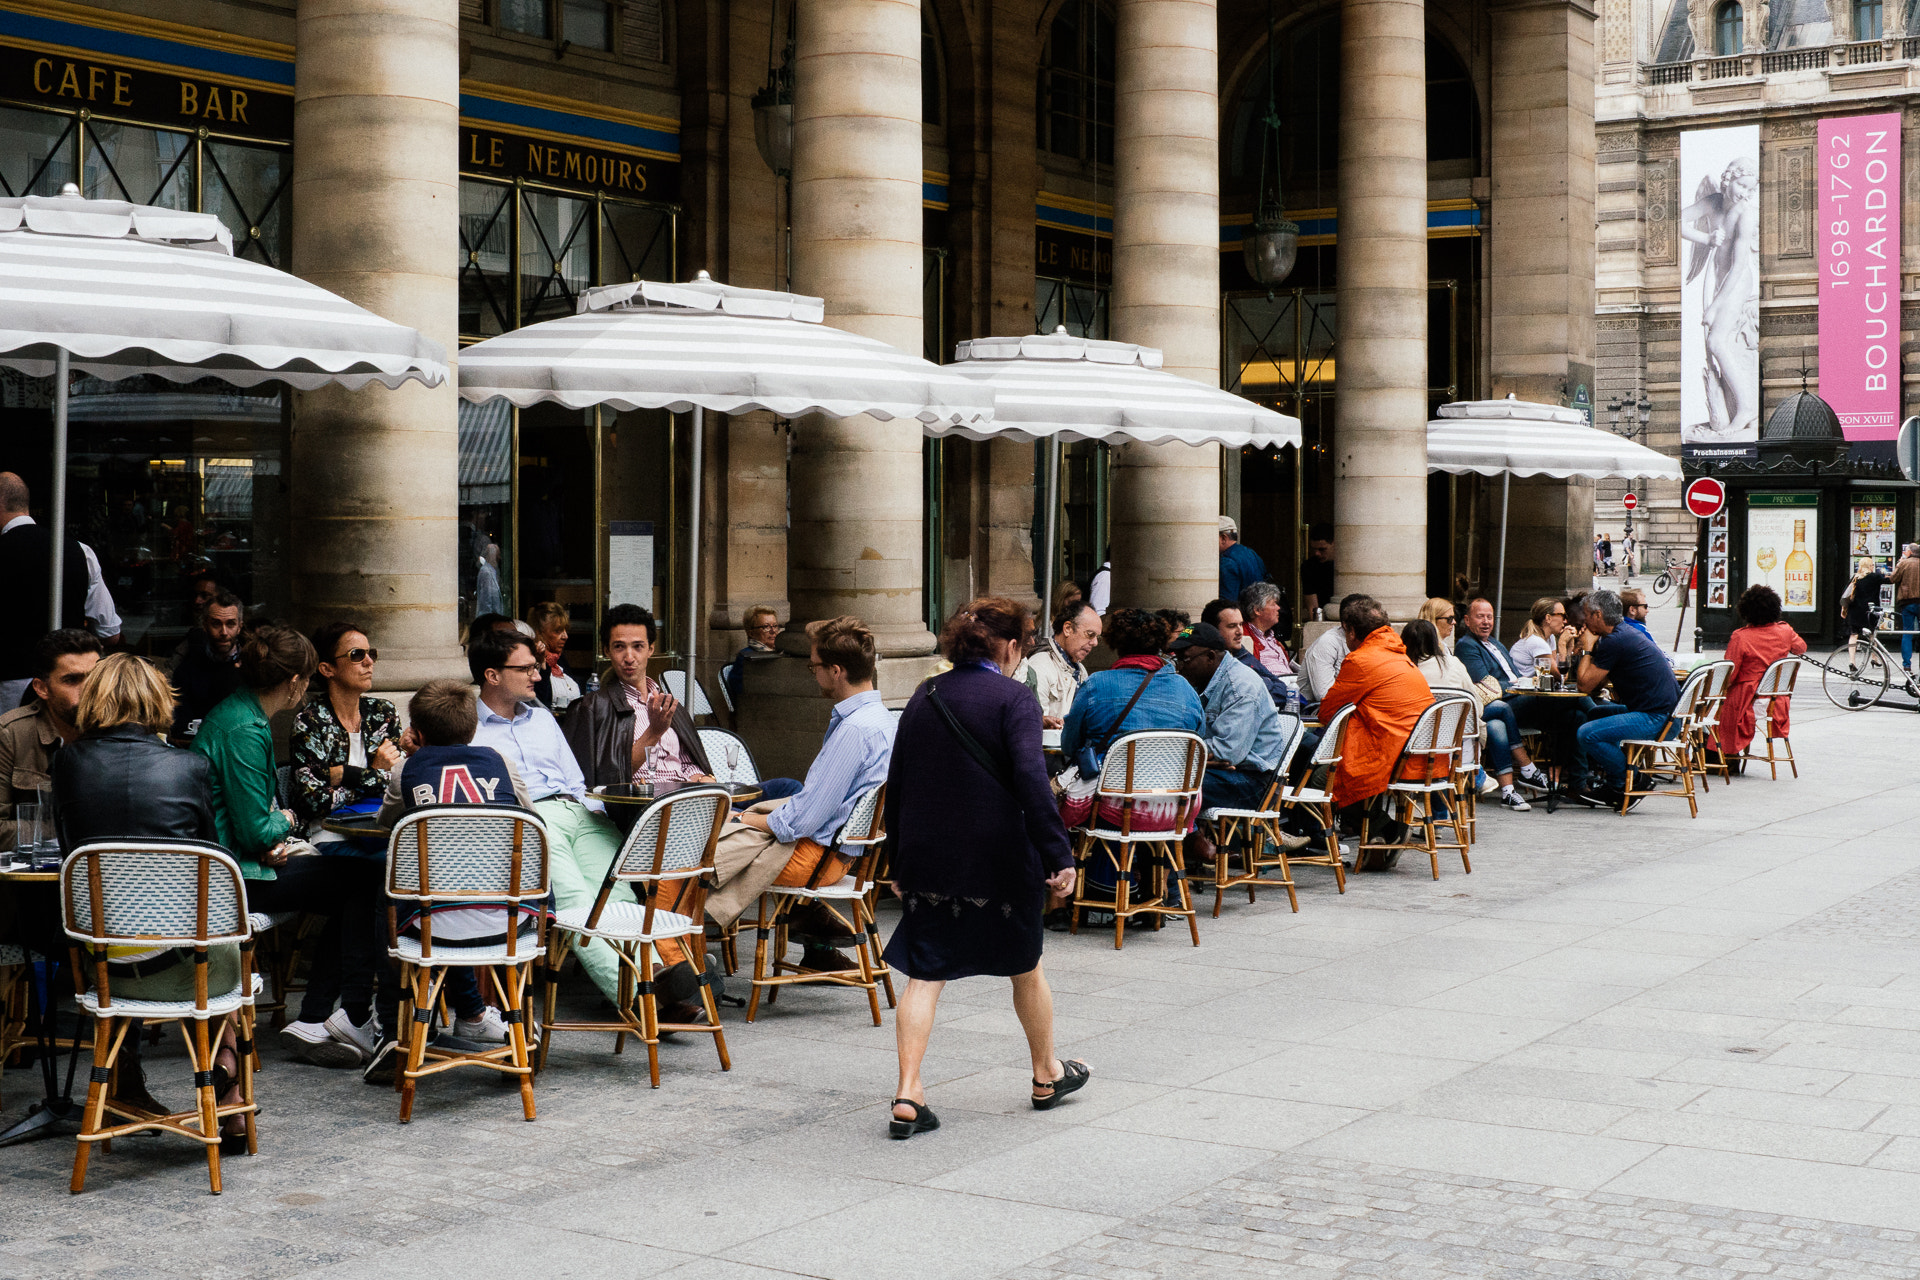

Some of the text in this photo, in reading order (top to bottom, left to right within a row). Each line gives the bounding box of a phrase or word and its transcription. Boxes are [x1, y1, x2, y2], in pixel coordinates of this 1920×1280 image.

[33, 58, 249, 125] CAFE BAR
[470, 134, 647, 192] LE NEMOURS
[1830, 133, 1852, 289] 1698-1762
[1038, 241, 1112, 274] LE NEMO
[1865, 130, 1887, 391] BOUCHARDON
[1839, 416, 1860, 424] SON
[1693, 448, 1747, 456] Prochainement
[413, 764, 499, 805] BAY
